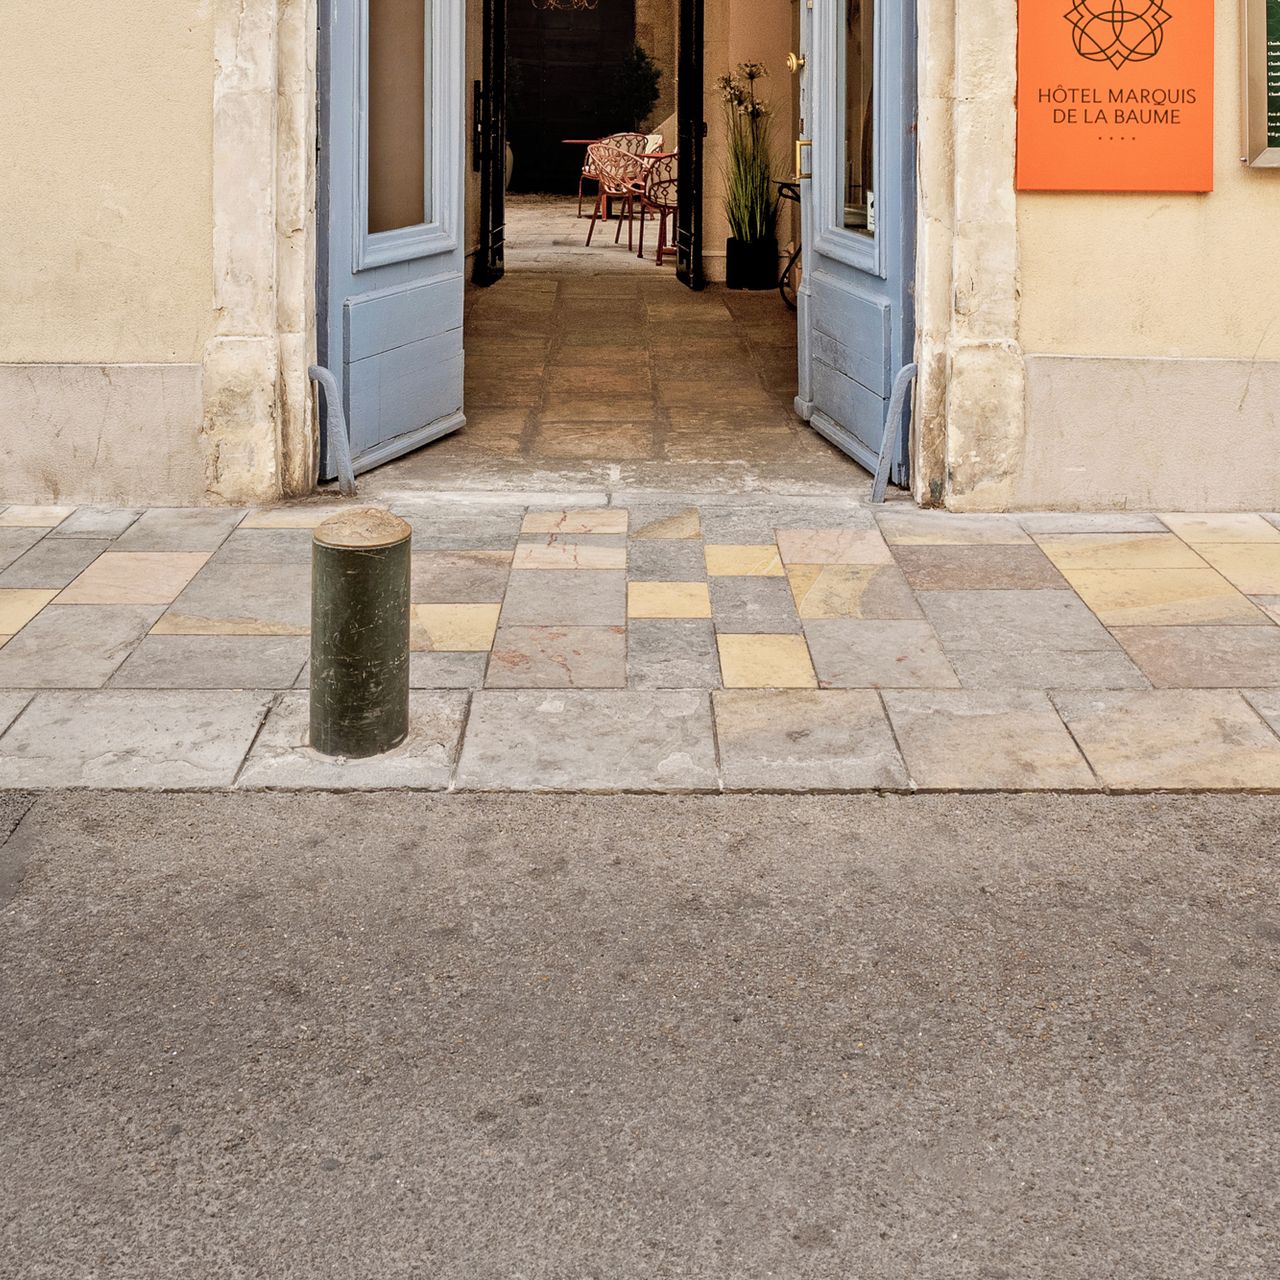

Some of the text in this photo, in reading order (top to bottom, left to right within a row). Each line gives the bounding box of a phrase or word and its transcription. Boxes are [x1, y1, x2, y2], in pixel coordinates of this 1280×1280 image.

[1038, 84, 1197, 106] HÔTEL MARQUIS
[1053, 108, 1181, 124] DE LA BAUME
